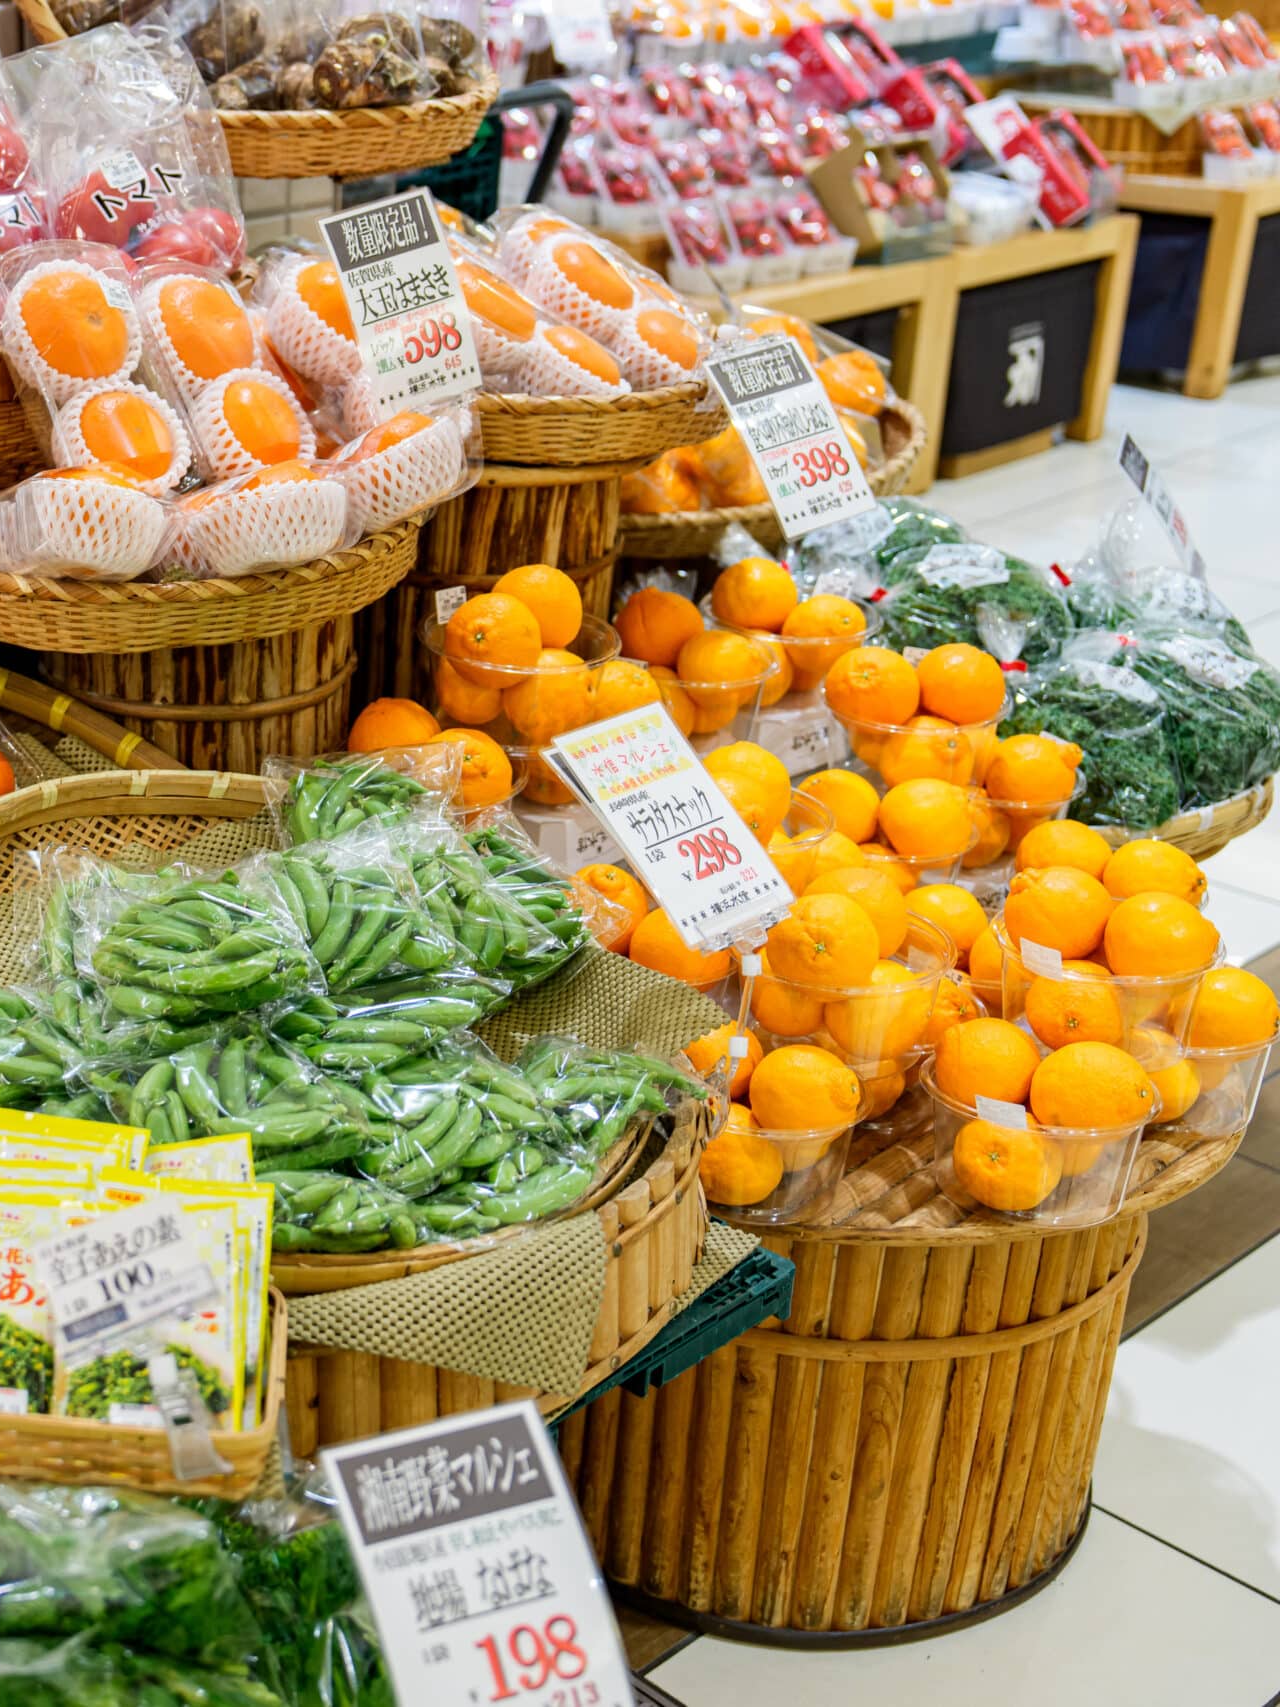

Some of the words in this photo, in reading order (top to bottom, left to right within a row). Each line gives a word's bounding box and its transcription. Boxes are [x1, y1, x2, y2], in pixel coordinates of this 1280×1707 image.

[94, 167, 183, 219] トマト
[347, 261, 396, 288] 佐賀県産
[401, 312, 463, 364] 598
[792, 441, 850, 487] 398
[626, 785, 714, 842] サラダスナック
[677, 827, 742, 880] 298
[355, 1436, 540, 1532] 湘南野菜マルシェ
[474, 1613, 588, 1702] 198
